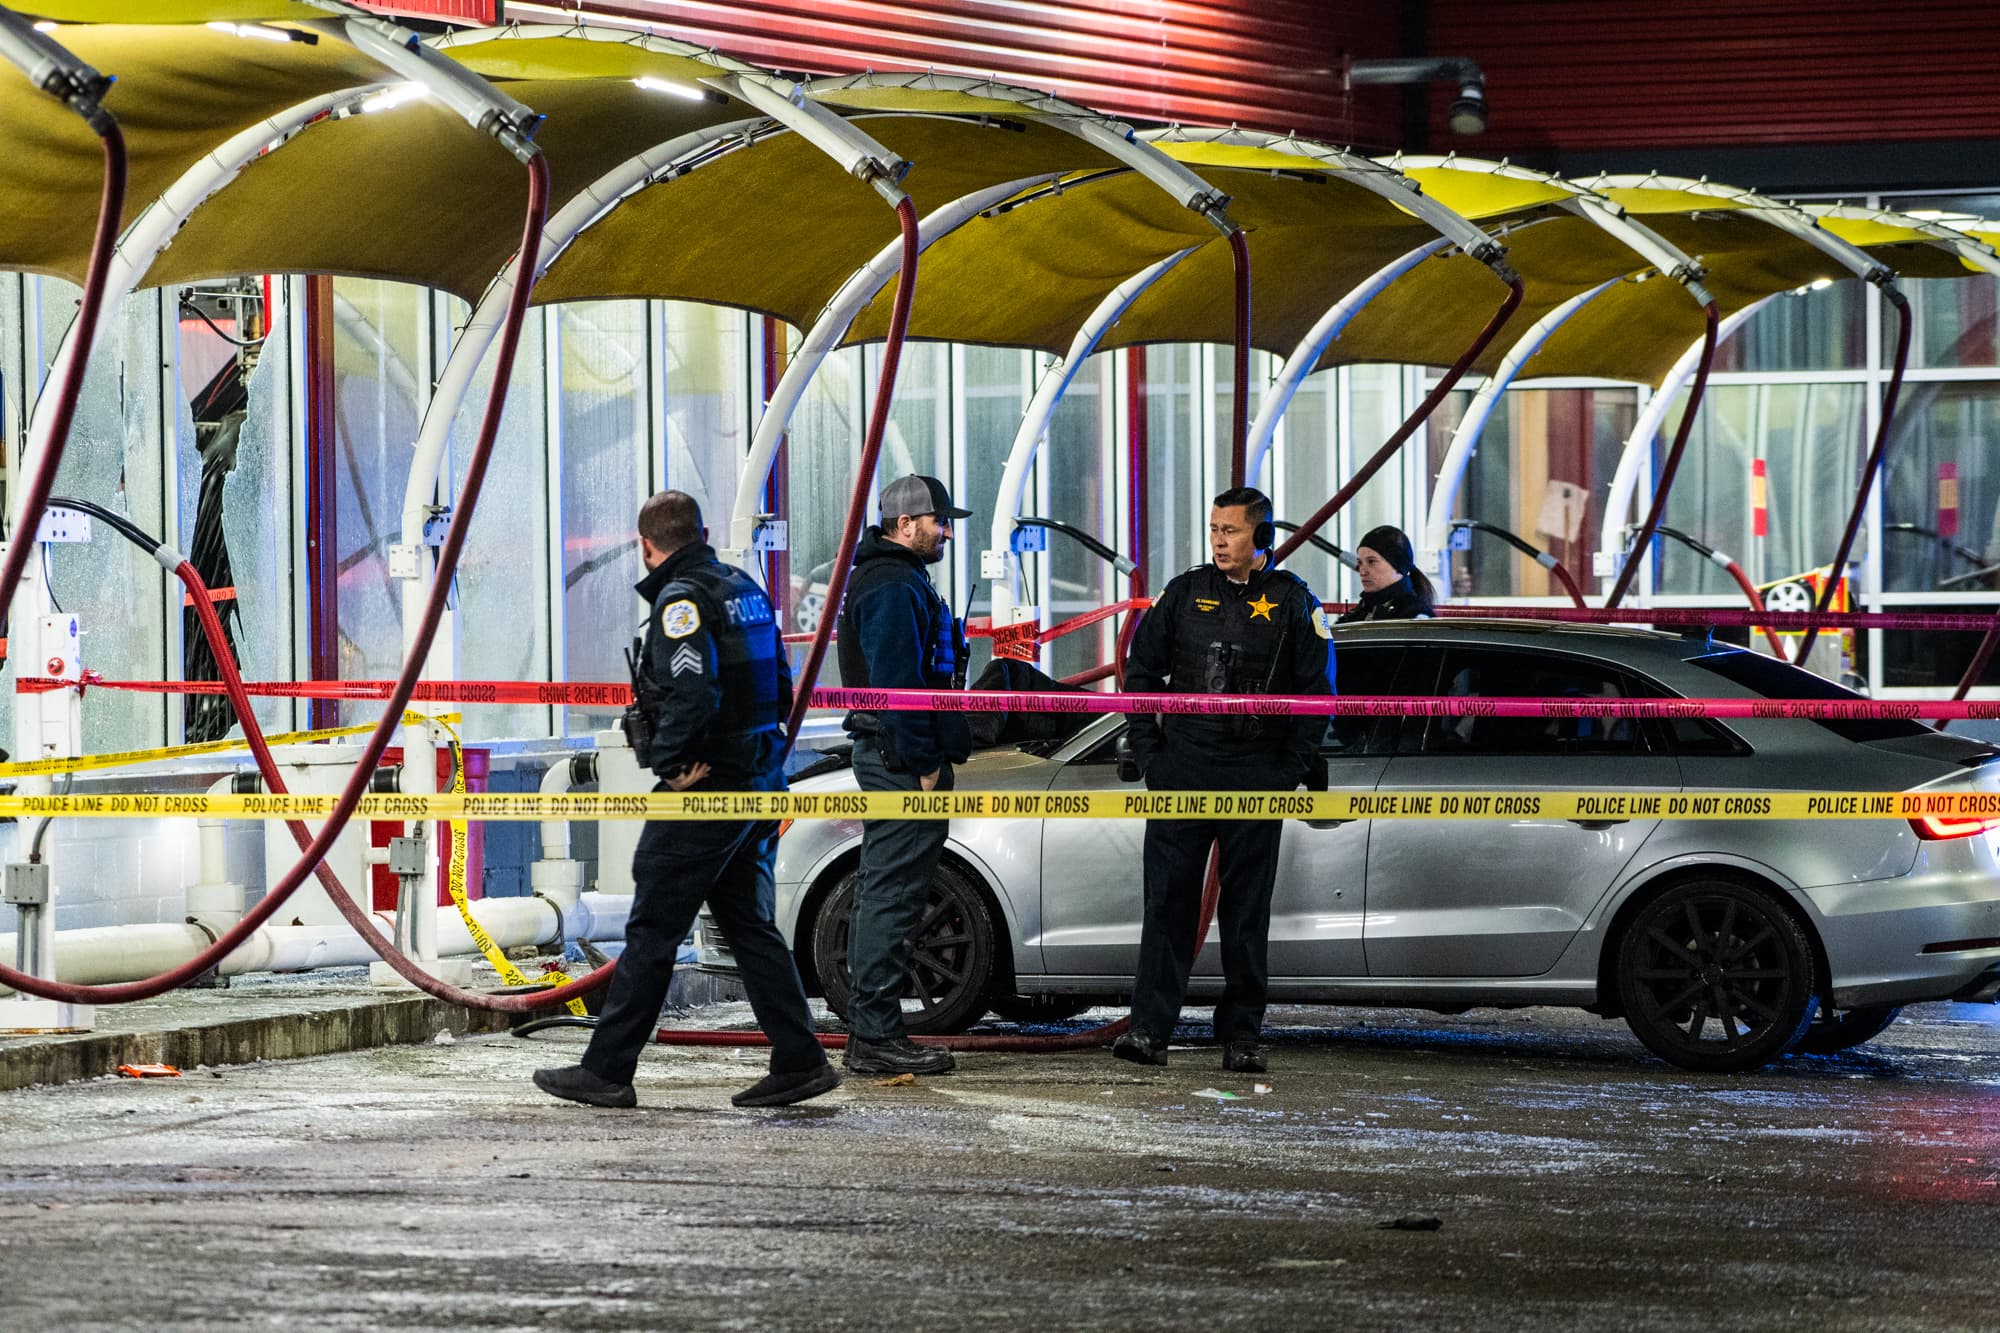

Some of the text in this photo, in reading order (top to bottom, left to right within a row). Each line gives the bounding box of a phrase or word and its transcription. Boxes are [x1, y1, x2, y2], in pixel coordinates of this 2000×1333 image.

[724, 595, 769, 624] POLICE
[994, 626, 1020, 645] SCENE
[23, 797, 208, 812] POLICE LINE DO NOT CROSS
[243, 797, 290, 813] POLICE
[294, 797, 323, 813] LINE
[384, 797, 428, 813] CROSS
[463, 797, 648, 814] POLICE LINE DO NOT CROSS
[682, 796, 868, 814] POLICE LINE DO NOT CROSS
[903, 795, 1090, 814] POLICE LINE DO NOT CROSS
[1125, 795, 1314, 814] POLICE LINE DO NOT CROSS
[1349, 796, 1540, 814] POLICE LINE DO NOT CROSS
[1576, 797, 1771, 814] POLICE LINE DO NOT CROSS
[1808, 796, 2000, 813] POLICE LINE DO NOT CROS
